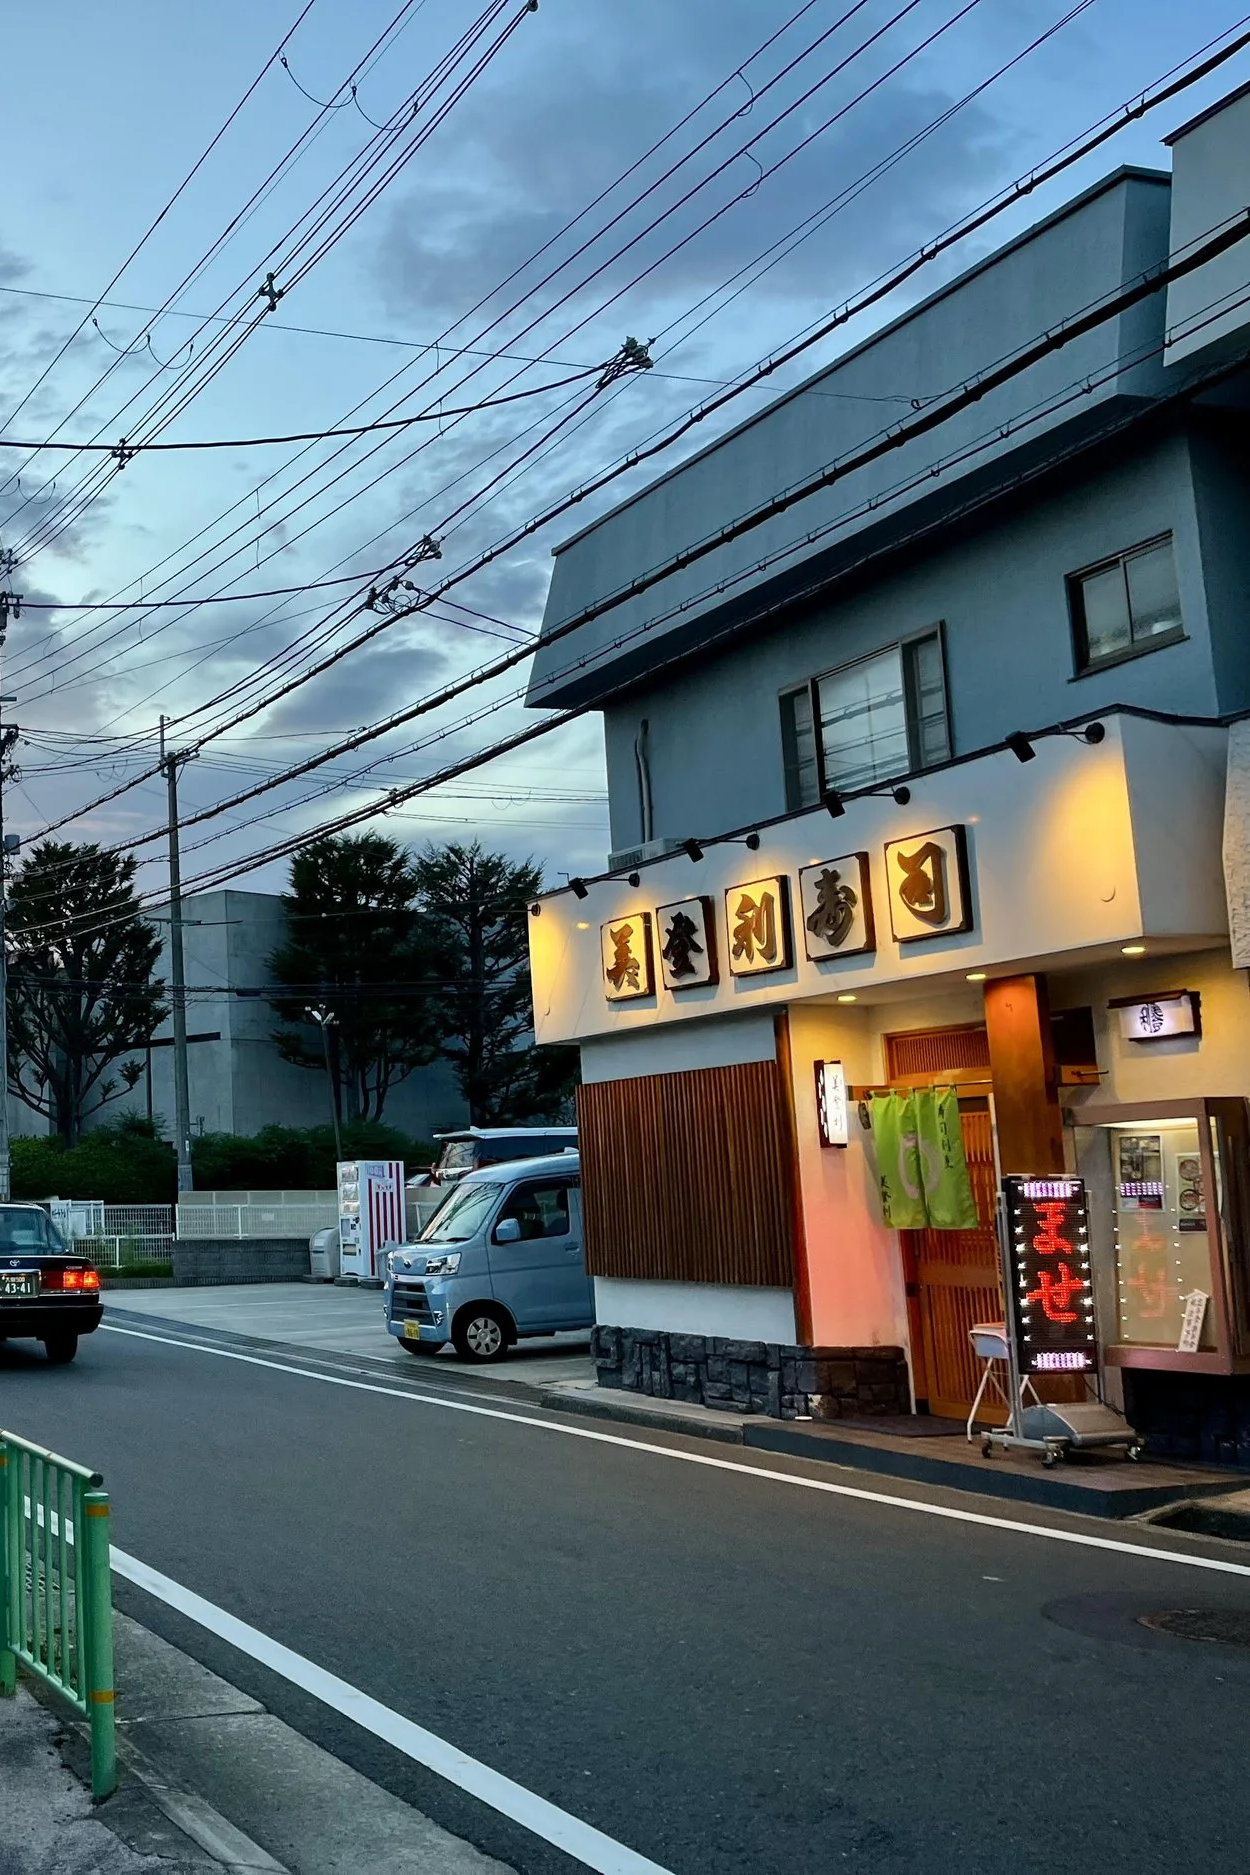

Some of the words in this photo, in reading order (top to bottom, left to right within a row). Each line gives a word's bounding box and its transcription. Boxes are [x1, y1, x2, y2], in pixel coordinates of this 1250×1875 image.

[605, 841, 949, 993] 美登利寿司
[1025, 1202, 1085, 1323] ませ
